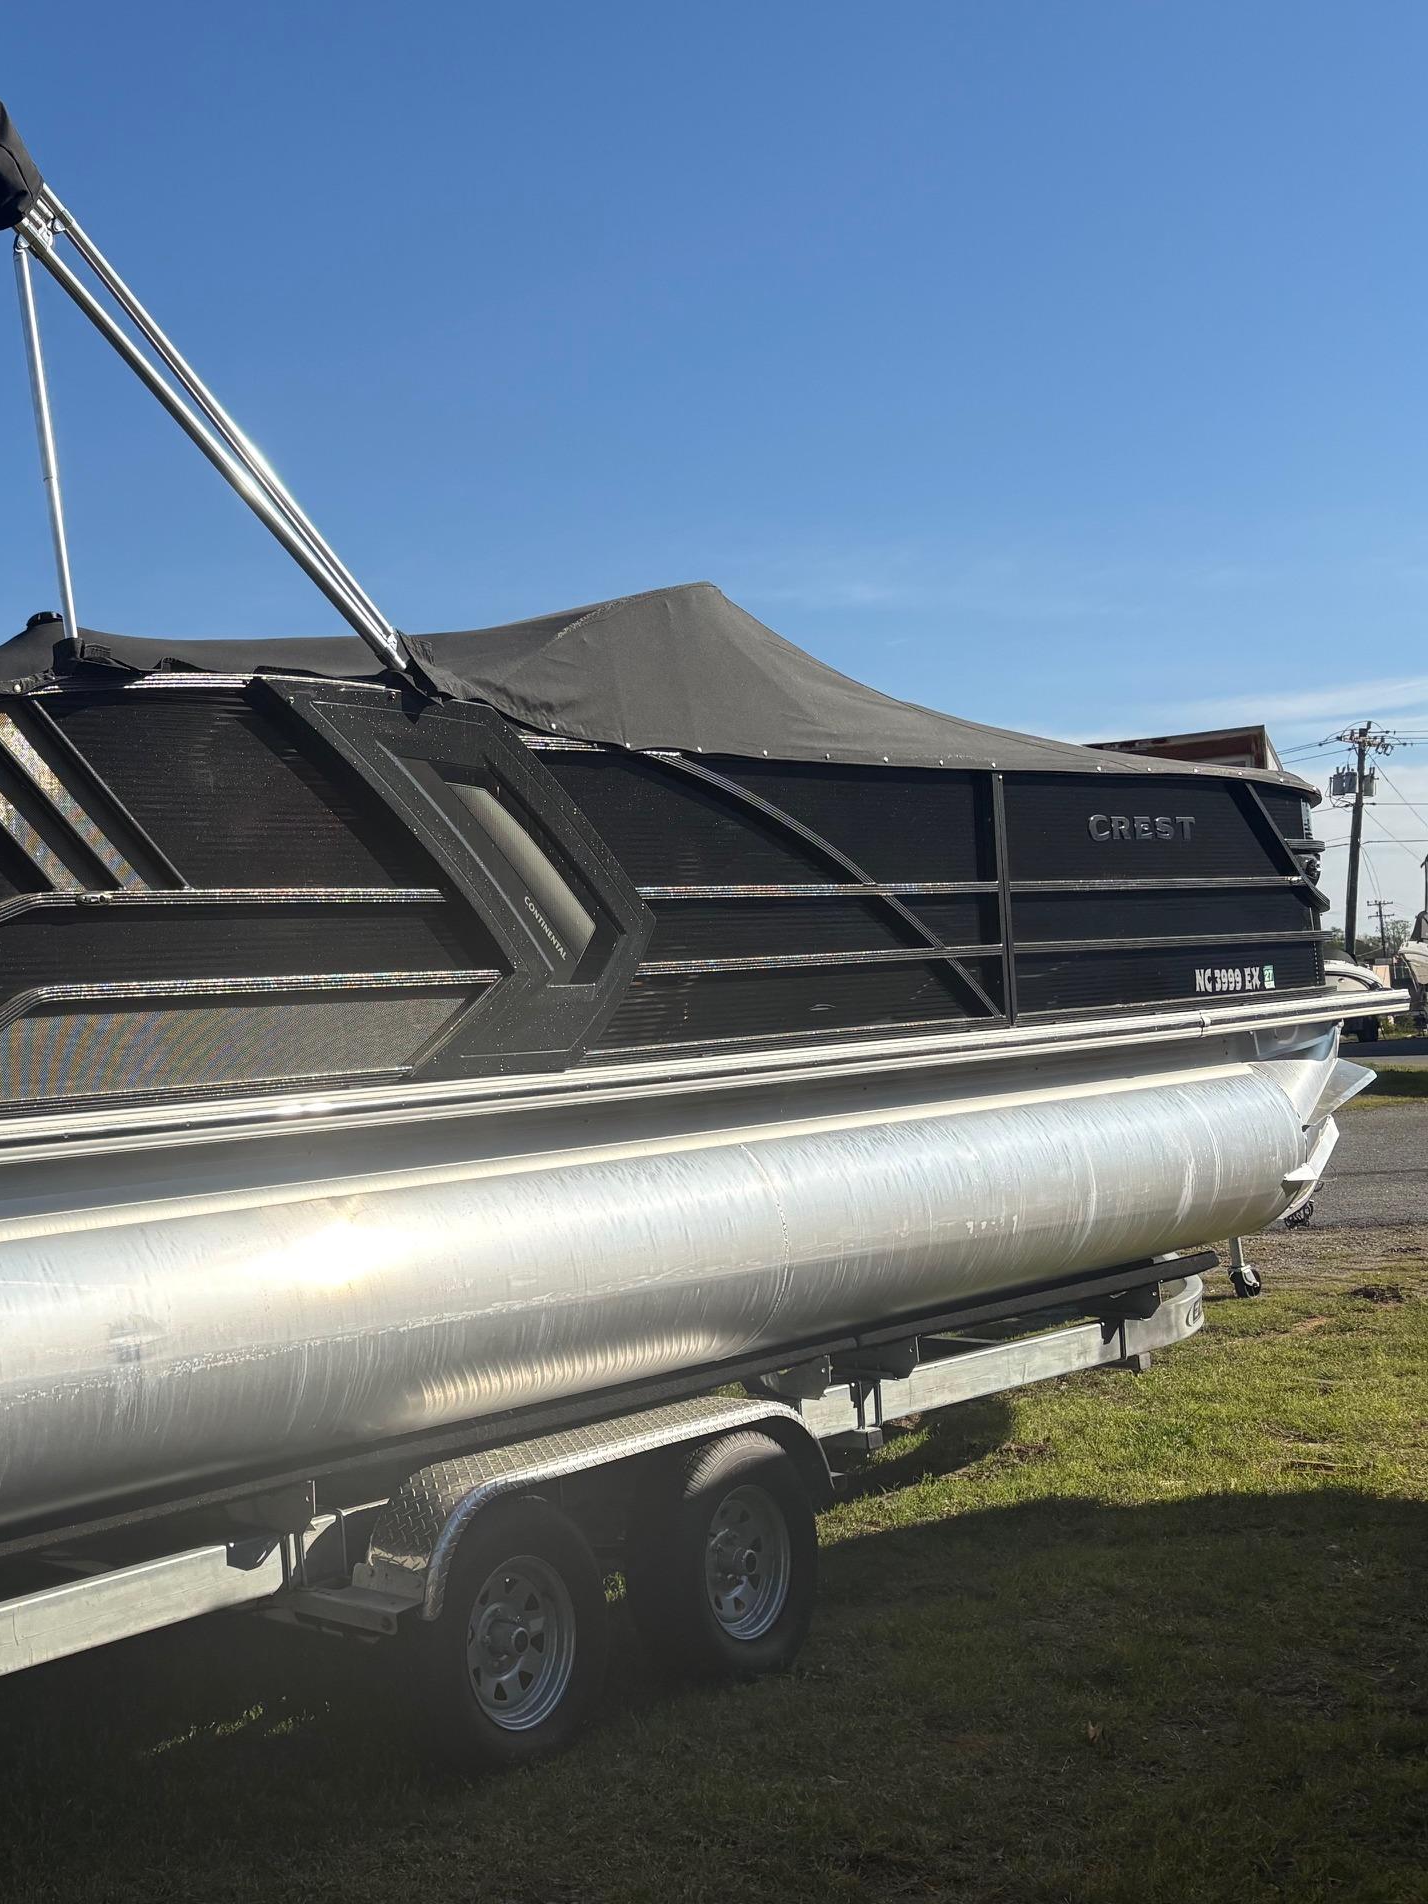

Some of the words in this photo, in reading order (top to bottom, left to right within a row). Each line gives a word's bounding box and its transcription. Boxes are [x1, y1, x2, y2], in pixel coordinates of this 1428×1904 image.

[1088, 814, 1196, 842] CREST
[524, 896, 567, 960] CONTINENTAL
[1194, 968, 1212, 993] NC
[1214, 968, 1242, 992] 3999
[1243, 966, 1261, 990] EX
